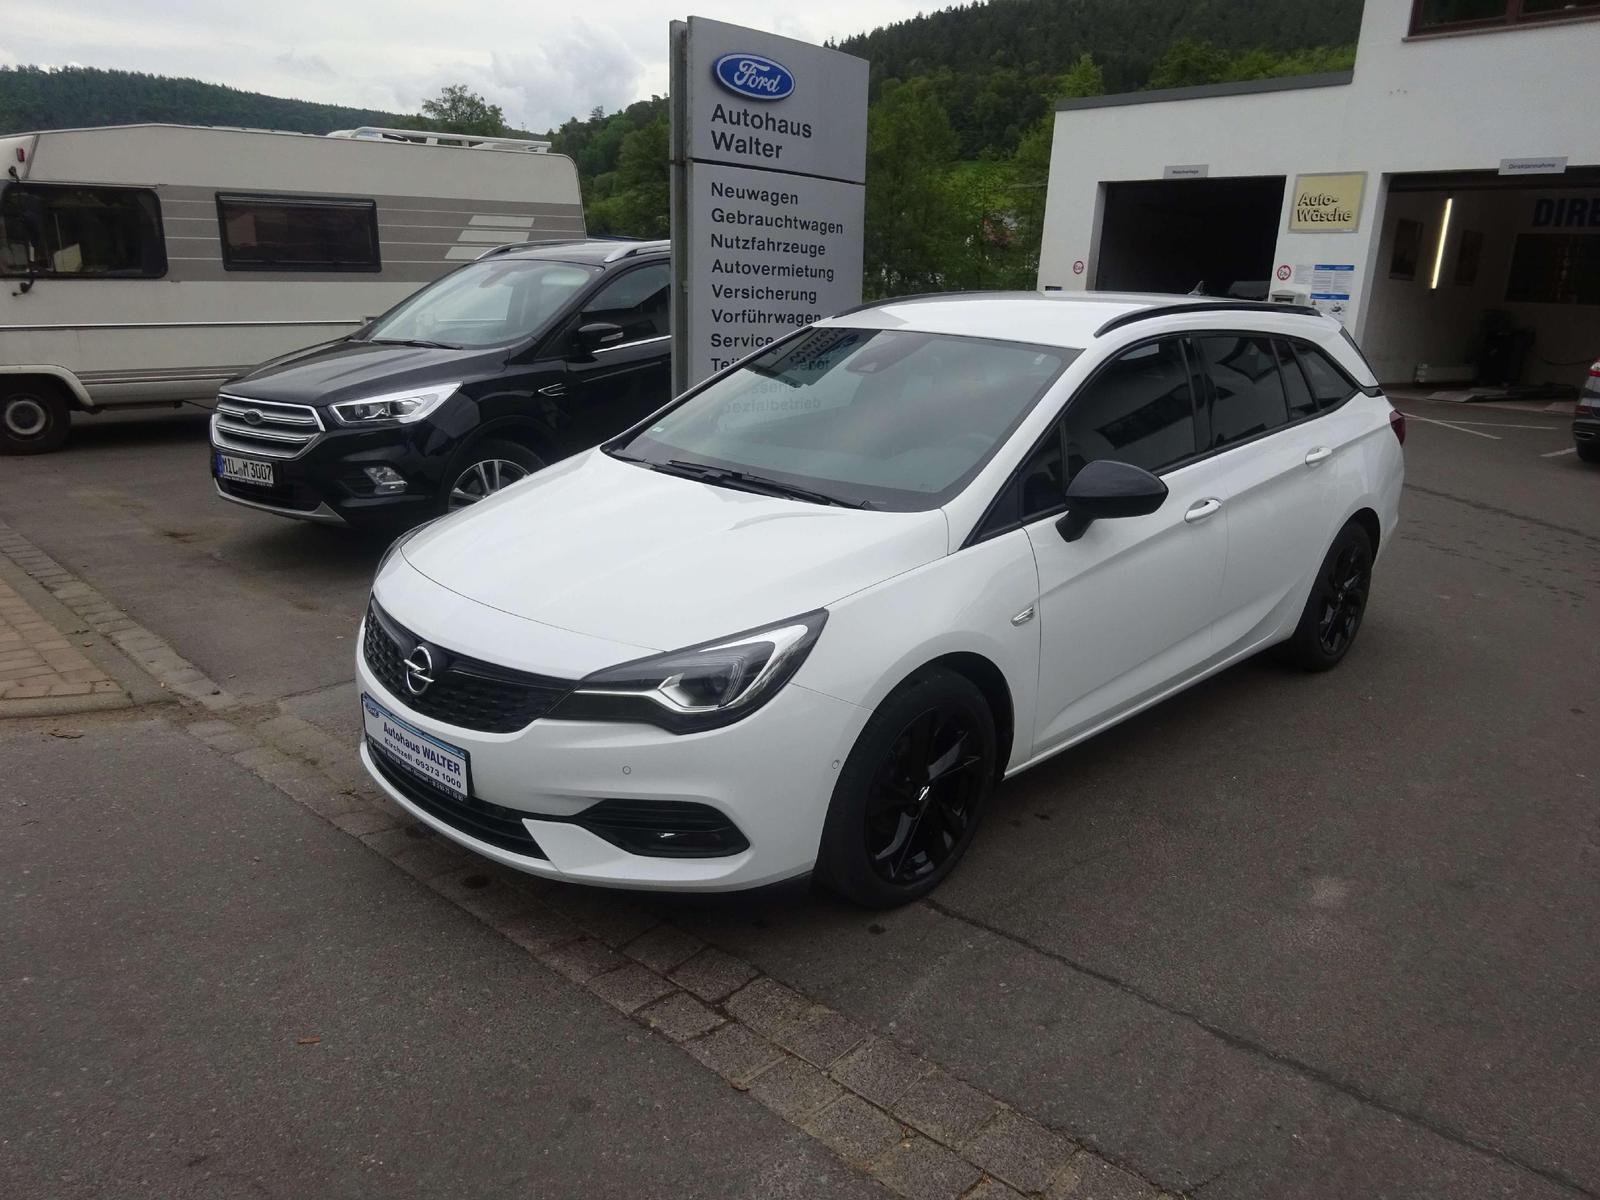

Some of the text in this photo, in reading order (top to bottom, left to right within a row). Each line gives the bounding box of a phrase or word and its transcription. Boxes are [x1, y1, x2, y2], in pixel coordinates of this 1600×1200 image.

[733, 60, 780, 93] Ford
[711, 103, 812, 138] Autohaus
[711, 130, 783, 159] Walter
[711, 182, 798, 206] Neuwagen
[1297, 192, 1338, 207] Auto-
[711, 208, 843, 235] Gebrauchtwagen
[1296, 207, 1353, 222] Wäsche
[711, 234, 826, 257] Nutzfahrzeuge
[711, 259, 834, 282] Autovermietung
[711, 284, 817, 304] Versicherung
[711, 309, 822, 327] Vorführwagen
[711, 333, 774, 348] Service
[383, 721, 421, 755] Autohaus
[421, 744, 461, 777] WALTER
